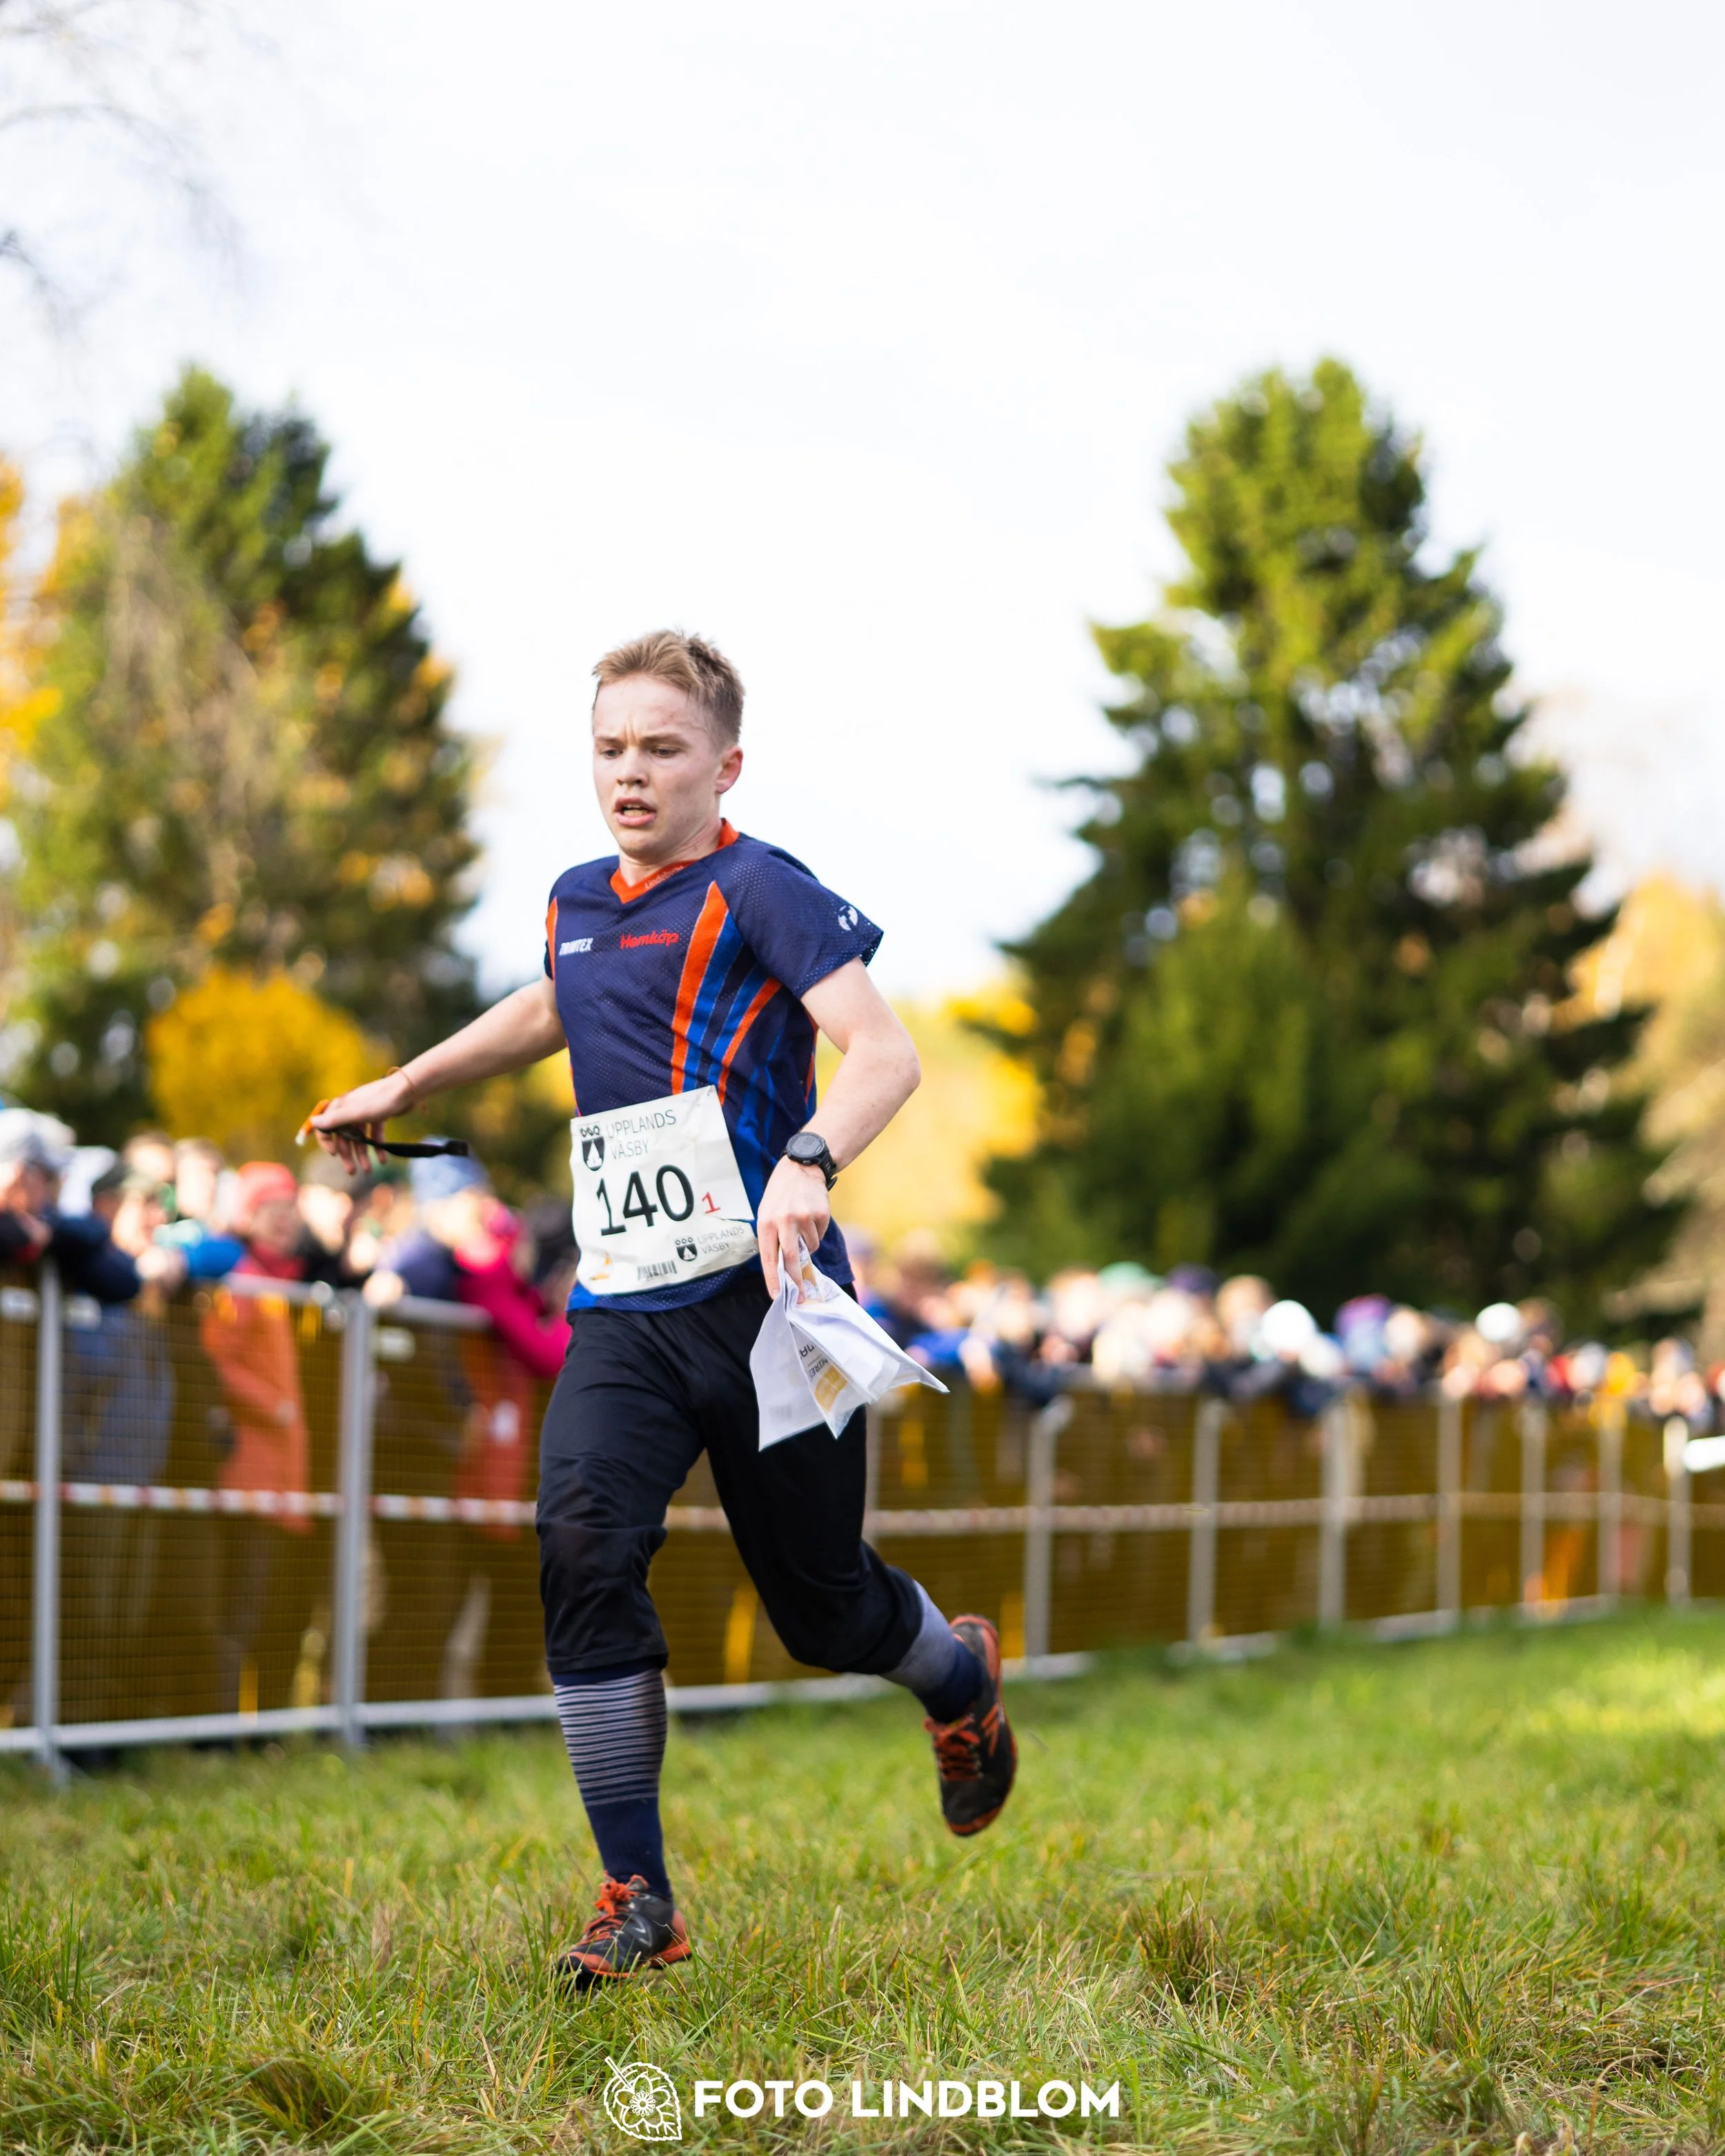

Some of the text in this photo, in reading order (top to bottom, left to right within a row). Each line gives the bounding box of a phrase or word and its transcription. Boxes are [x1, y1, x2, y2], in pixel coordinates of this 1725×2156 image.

[620, 929, 679, 949] Hemköp
[606, 1109, 676, 1138] UPPLANDS
[596, 1164, 694, 1236] 140
[701, 1191, 721, 1214] 1
[697, 1225, 745, 1244] UPPLANDS
